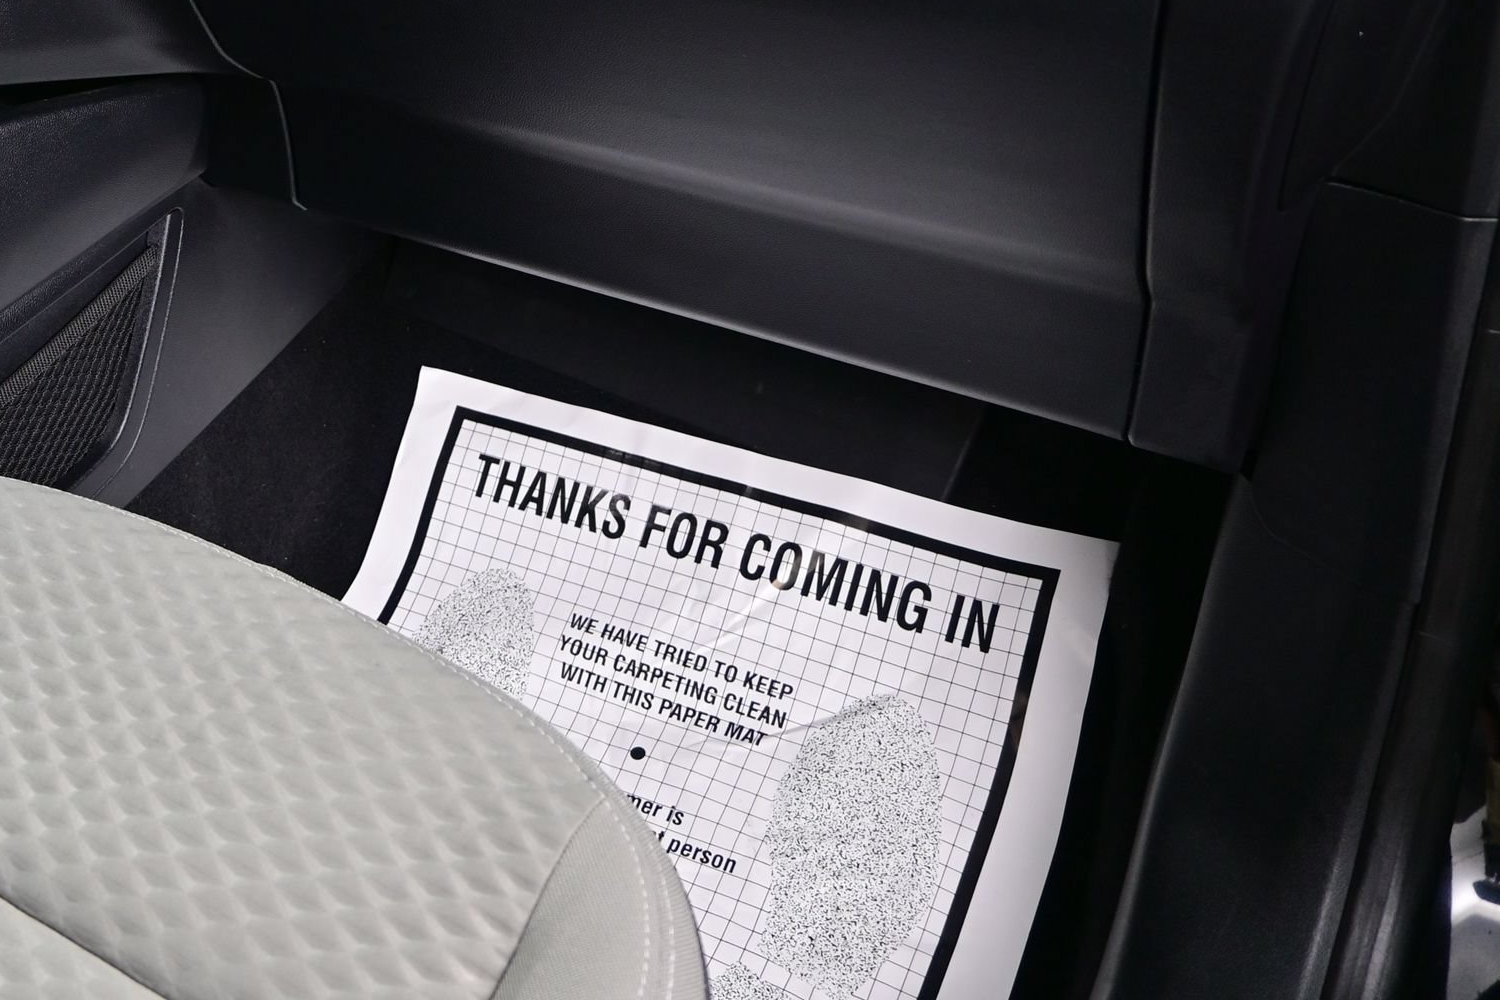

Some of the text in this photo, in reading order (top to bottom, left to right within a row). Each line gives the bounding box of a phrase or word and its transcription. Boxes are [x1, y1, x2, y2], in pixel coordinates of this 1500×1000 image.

[475, 454, 1000, 653] THANKS FOR COMING IN
[560, 634, 787, 729] YOUR CARPETING CLEAN
[570, 613, 794, 700] WE HAVE TRIED TO KEEP
[560, 662, 769, 747] WITH THIS PAPER MAT
[666, 806, 684, 826] is
[667, 837, 737, 874] person
